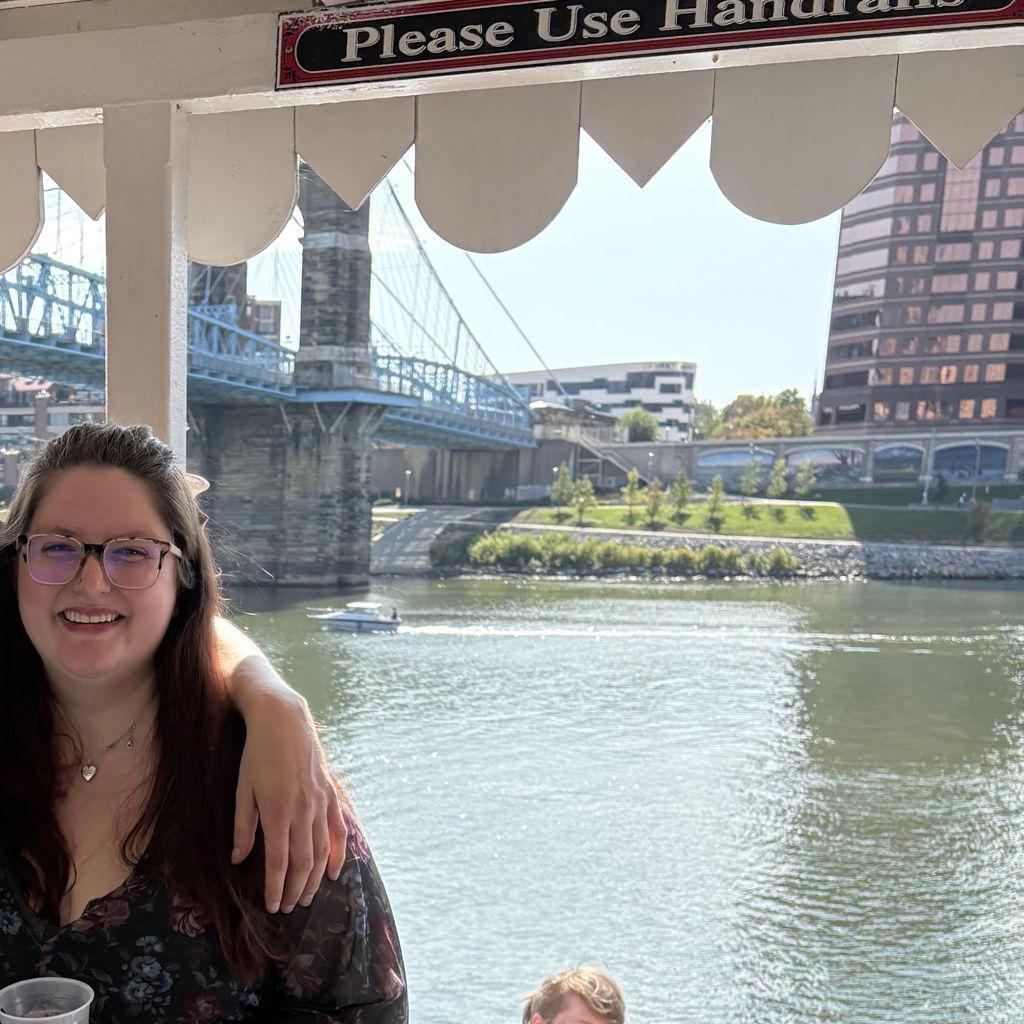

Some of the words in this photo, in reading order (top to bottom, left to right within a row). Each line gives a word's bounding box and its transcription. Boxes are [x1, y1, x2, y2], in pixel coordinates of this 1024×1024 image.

[340, 21, 515, 63] Please
[534, 4, 640, 42] Use
[659, 0, 964, 31] Handra
